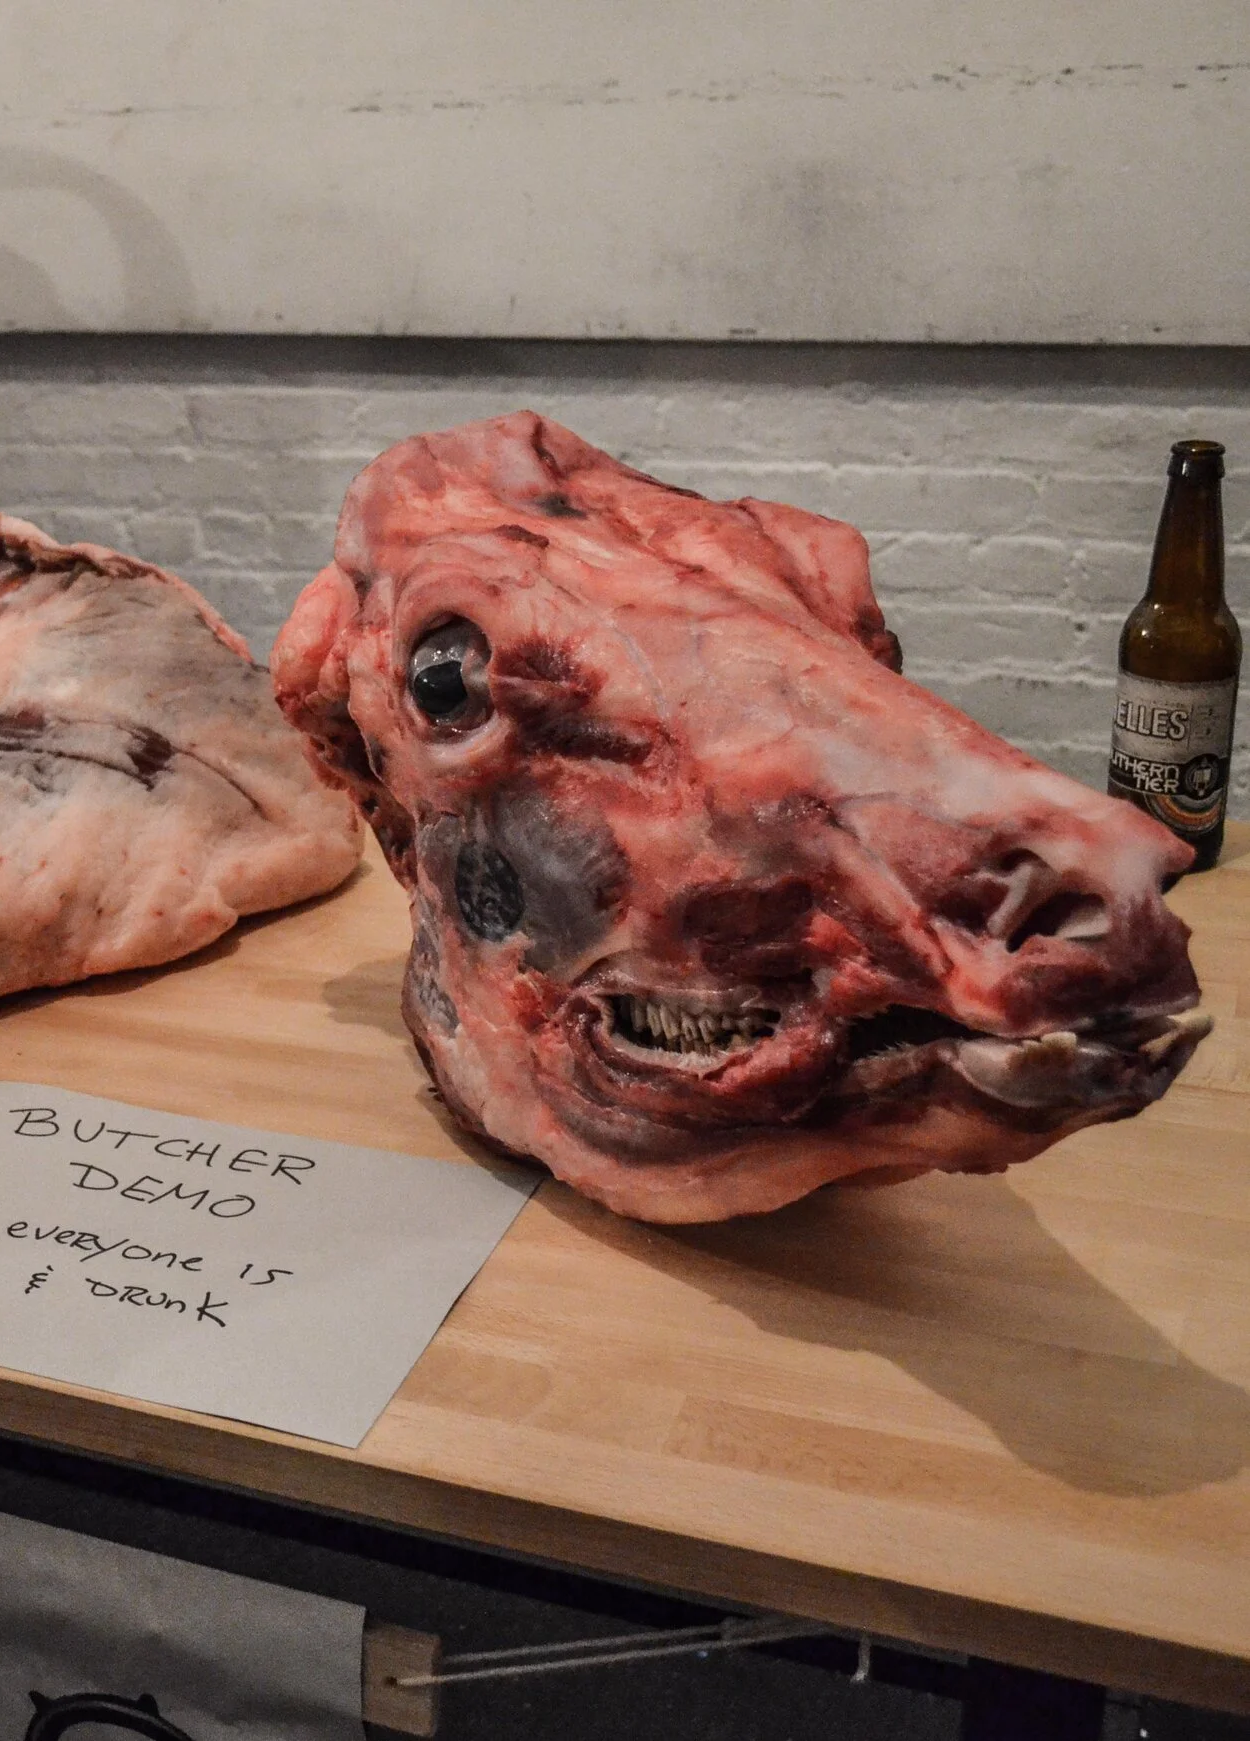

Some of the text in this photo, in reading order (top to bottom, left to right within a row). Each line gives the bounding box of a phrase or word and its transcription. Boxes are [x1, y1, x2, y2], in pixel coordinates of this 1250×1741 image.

[1133, 771, 1180, 794] TIER
[9, 1107, 316, 1185] BUTCHER
[69, 1161, 256, 1218] DEMO
